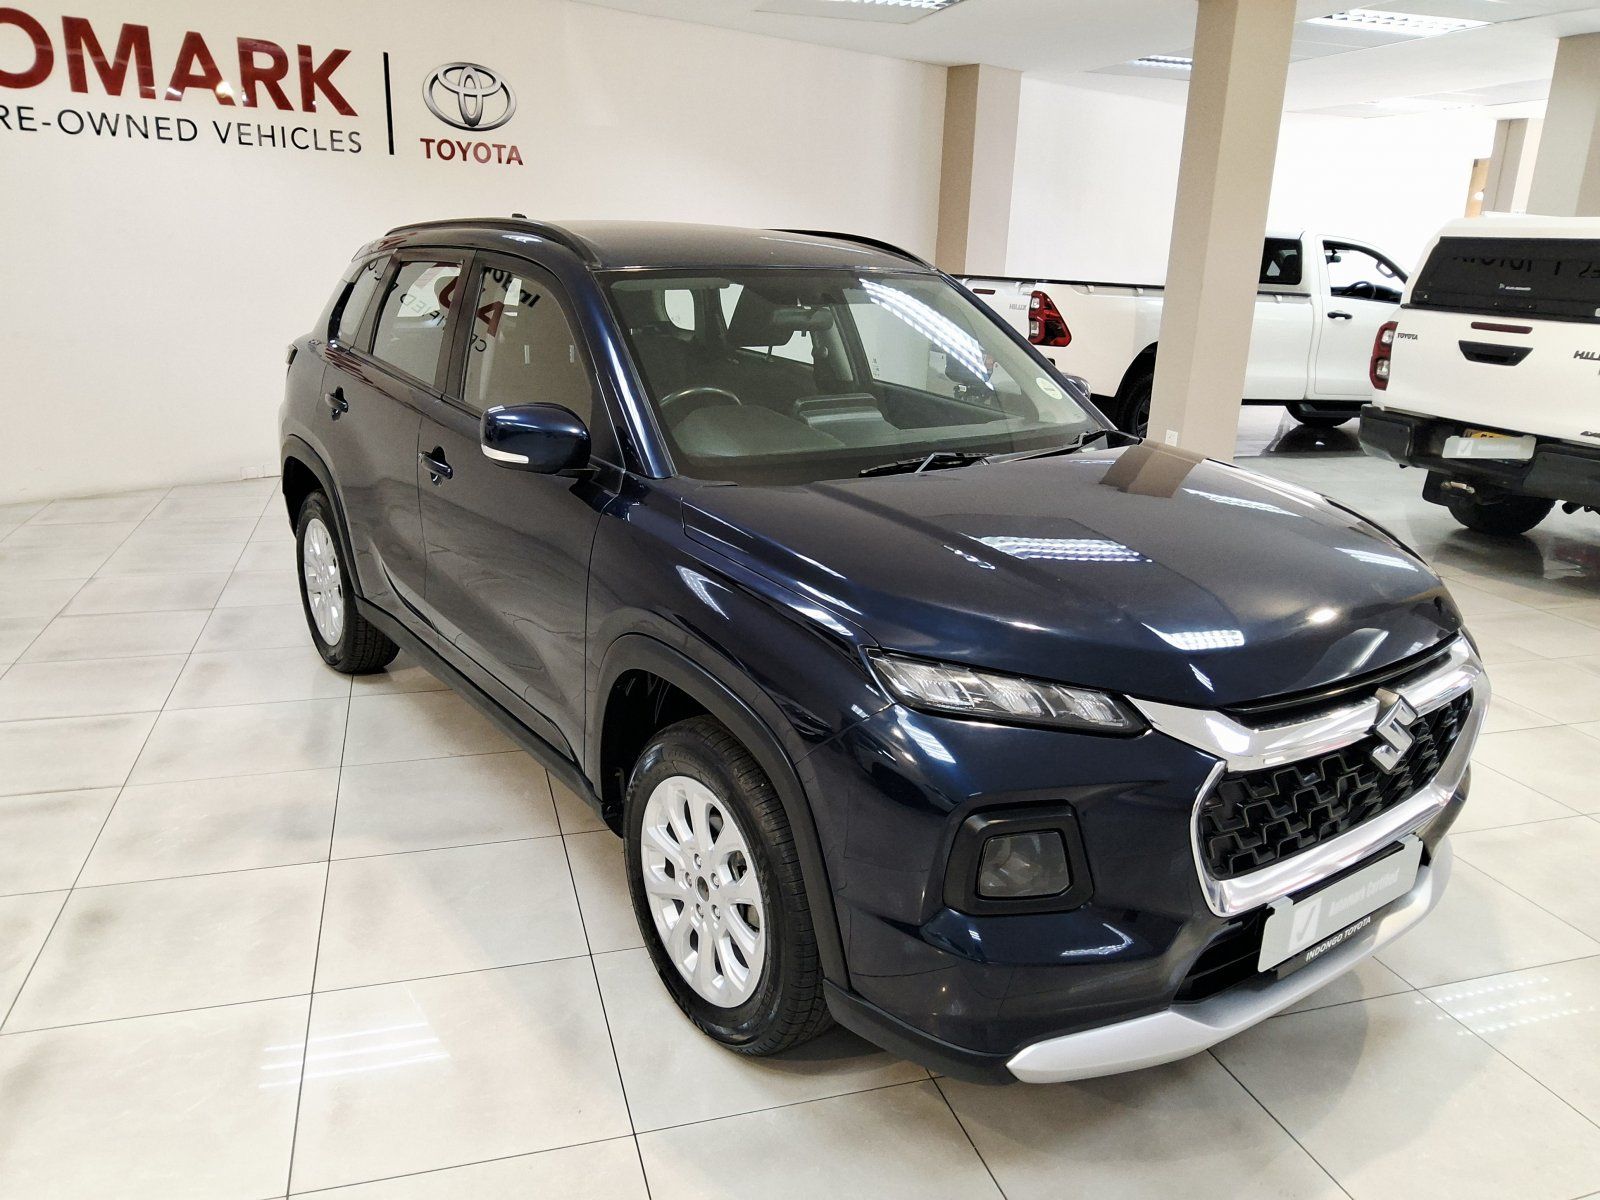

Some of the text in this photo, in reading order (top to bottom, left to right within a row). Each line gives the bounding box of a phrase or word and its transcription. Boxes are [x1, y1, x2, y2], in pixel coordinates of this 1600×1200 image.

[213, 120, 362, 154] VEHICLES
[420, 138, 524, 165] TOYOTA
[1397, 332, 1418, 341] TOYOTA
[1573, 350, 1600, 361] HIL
[1305, 915, 1371, 962] INDONGO TOYOTA
